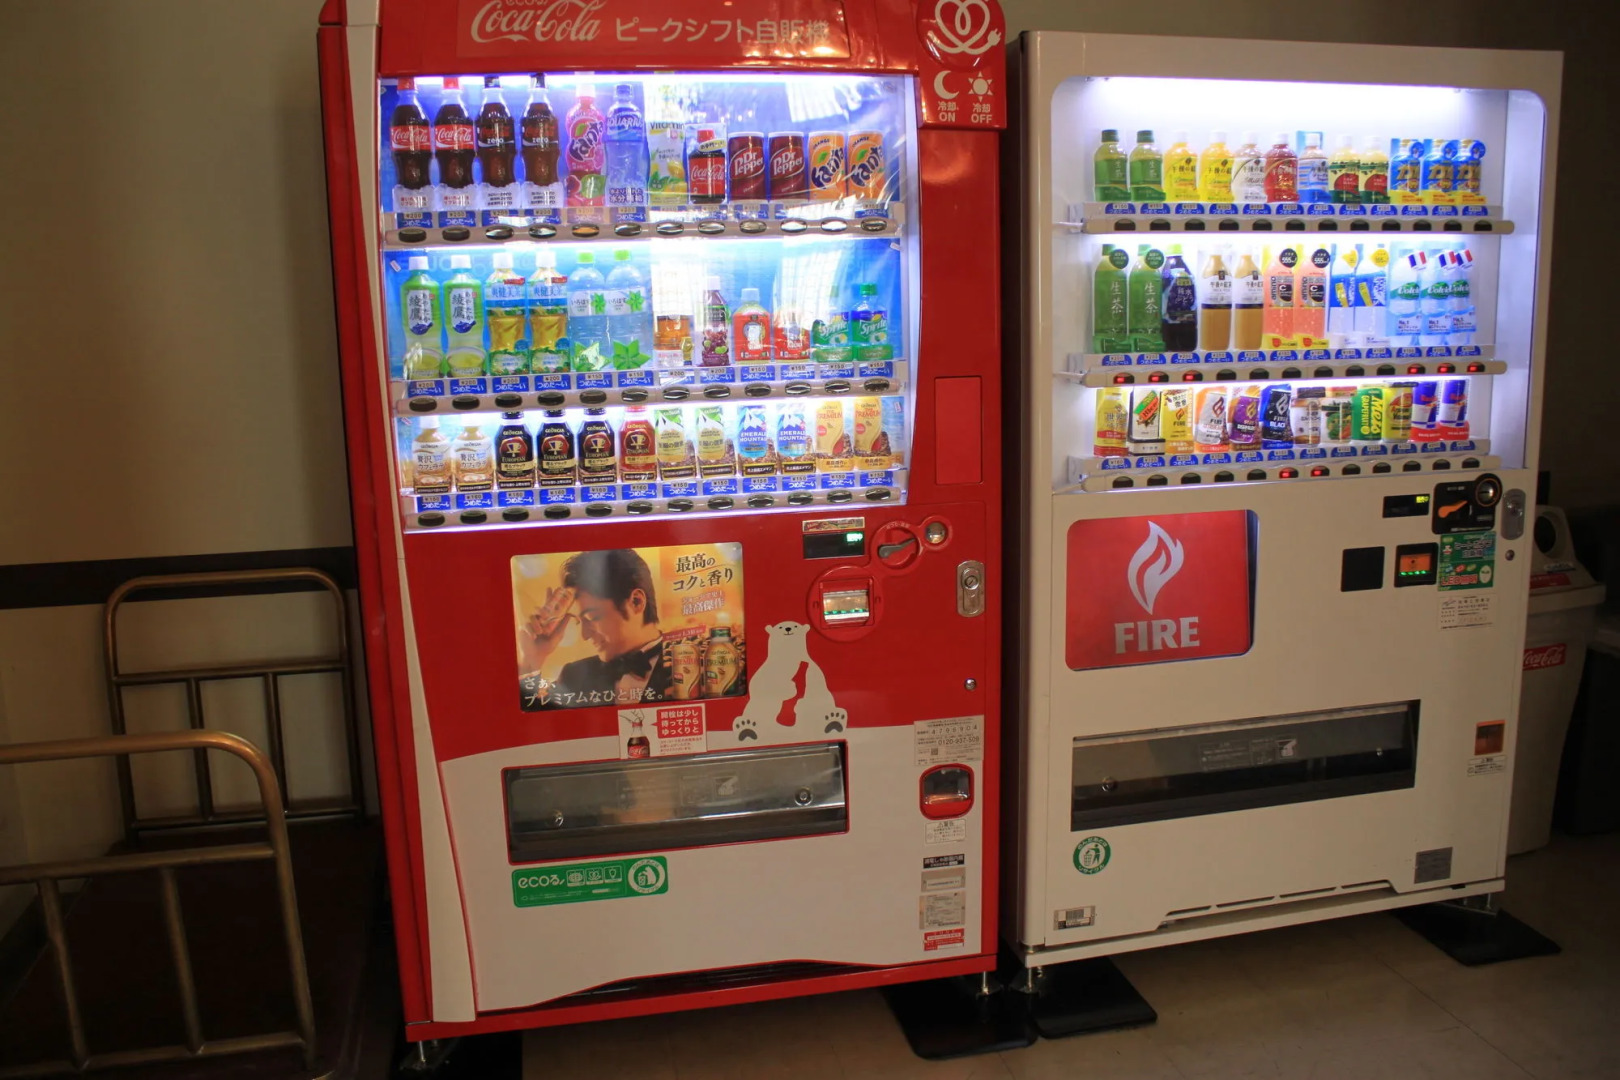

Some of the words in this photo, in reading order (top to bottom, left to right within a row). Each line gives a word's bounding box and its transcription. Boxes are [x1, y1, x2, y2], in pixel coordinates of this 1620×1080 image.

[471, 0, 607, 43] Coca-Cola
[616, 17, 830, 43] ピークシフト自販機
[937, 100, 957, 111] 冷却
[972, 102, 991, 113] 冷却
[939, 112, 955, 122] ON
[971, 113, 992, 124] OFF
[438, 127, 472, 142] Coca-Cola
[743, 151, 756, 164] Dr
[782, 150, 795, 163] Dr
[734, 157, 763, 175] Pepper
[773, 156, 802, 174] Pepper
[1111, 281, 1124, 314] 生茶
[1144, 281, 1158, 314] 生茶
[675, 553, 716, 573] 最高の
[673, 567, 734, 591] コクと香り
[682, 598, 724, 615] 最高傑作
[1114, 616, 1200, 654] FIRE
[524, 676, 557, 690] さぁ、
[524, 687, 664, 708] プレミアムなひと時を。
[660, 710, 699, 719] 開栓は少し
[661, 718, 699, 727] 待ってから
[661, 727, 700, 736] ゆっくりと
